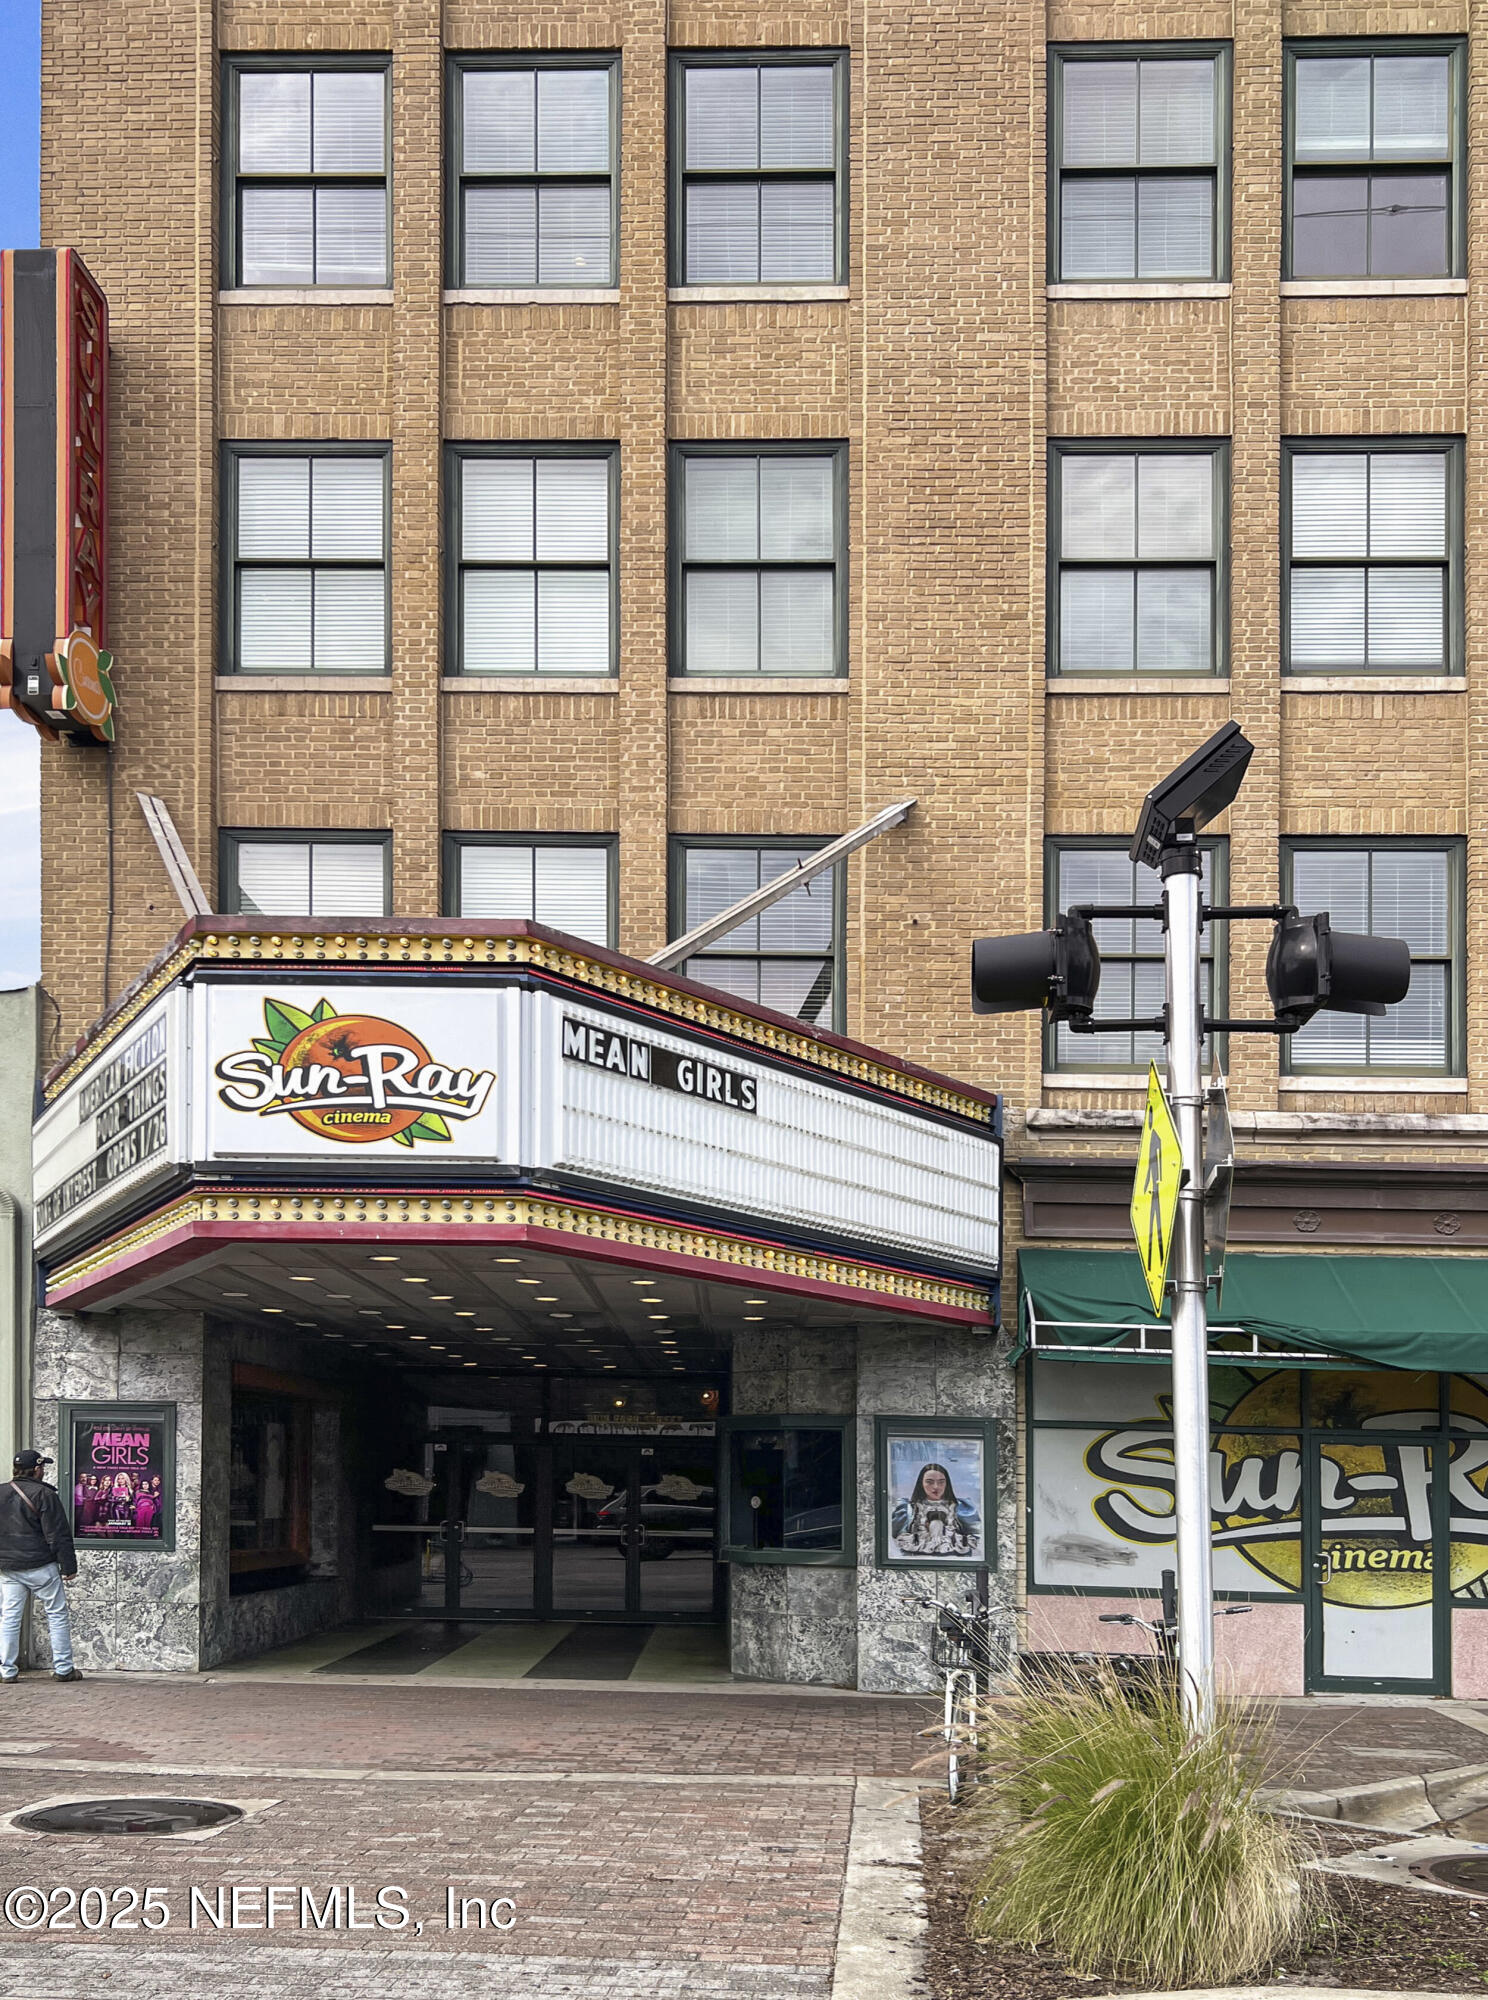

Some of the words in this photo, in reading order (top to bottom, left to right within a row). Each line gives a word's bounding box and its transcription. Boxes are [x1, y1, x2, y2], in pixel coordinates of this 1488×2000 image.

[127, 1063, 166, 1122] THINGS
[217, 1044, 496, 1118] Sun-Ray
[564, 1020, 649, 1079] MEAN
[677, 1059, 756, 1110] GIRLS
[107, 1131, 137, 1180] OPENS
[140, 1110, 166, 1159] 1/26
[322, 1110, 392, 1125] cinema
[91, 1446, 149, 1465] GIRLS
[92, 1432, 151, 1447] MEAN
